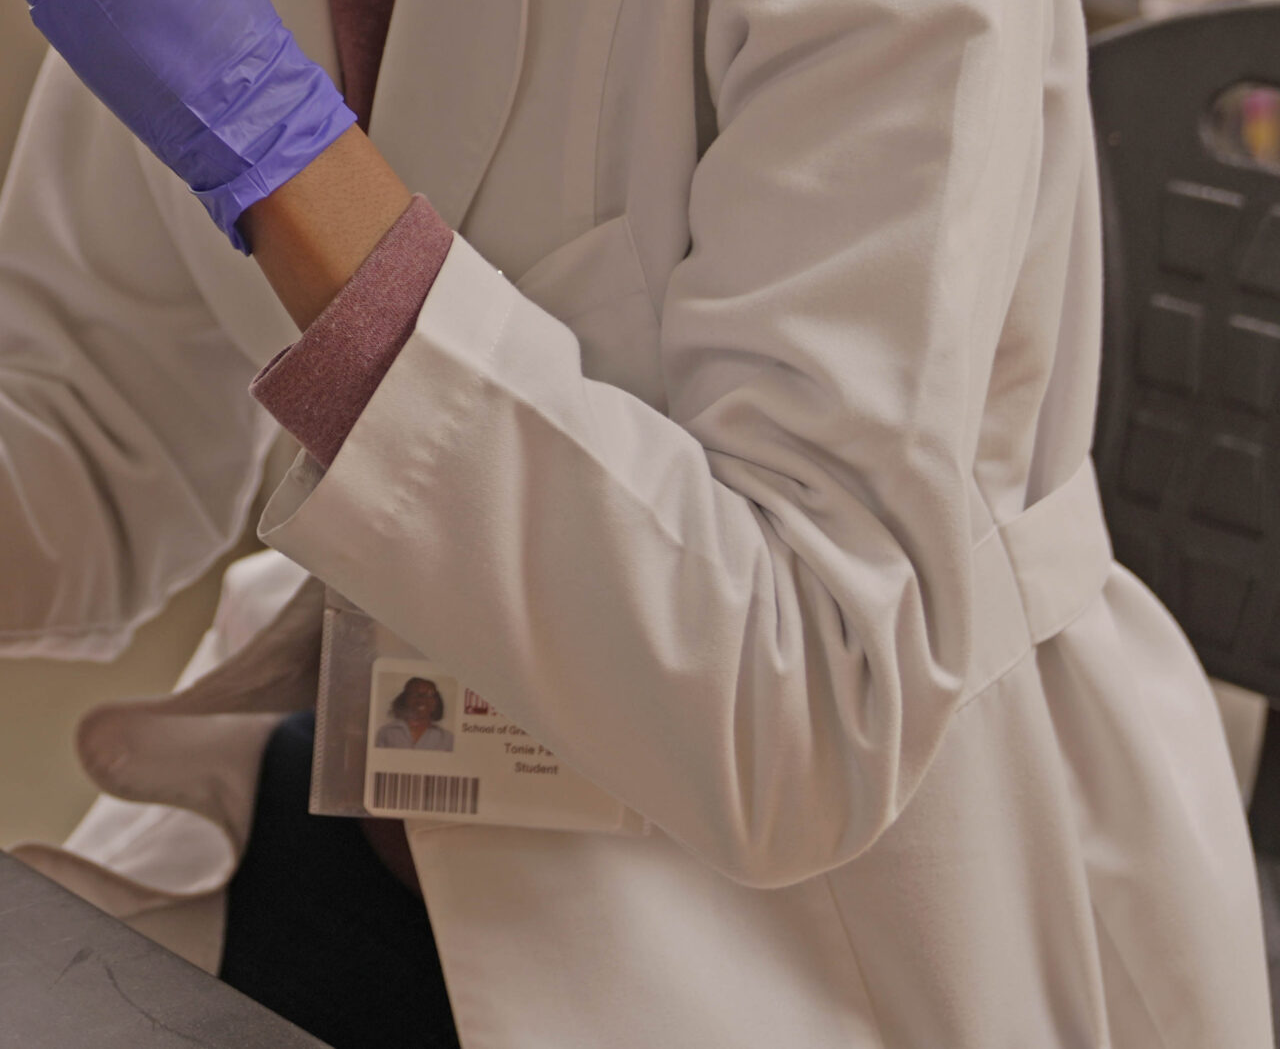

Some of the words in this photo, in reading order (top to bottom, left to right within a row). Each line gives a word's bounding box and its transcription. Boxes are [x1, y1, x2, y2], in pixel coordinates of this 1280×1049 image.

[461, 722, 495, 735] School
[496, 724, 508, 735] of
[514, 761, 559, 775] Student
